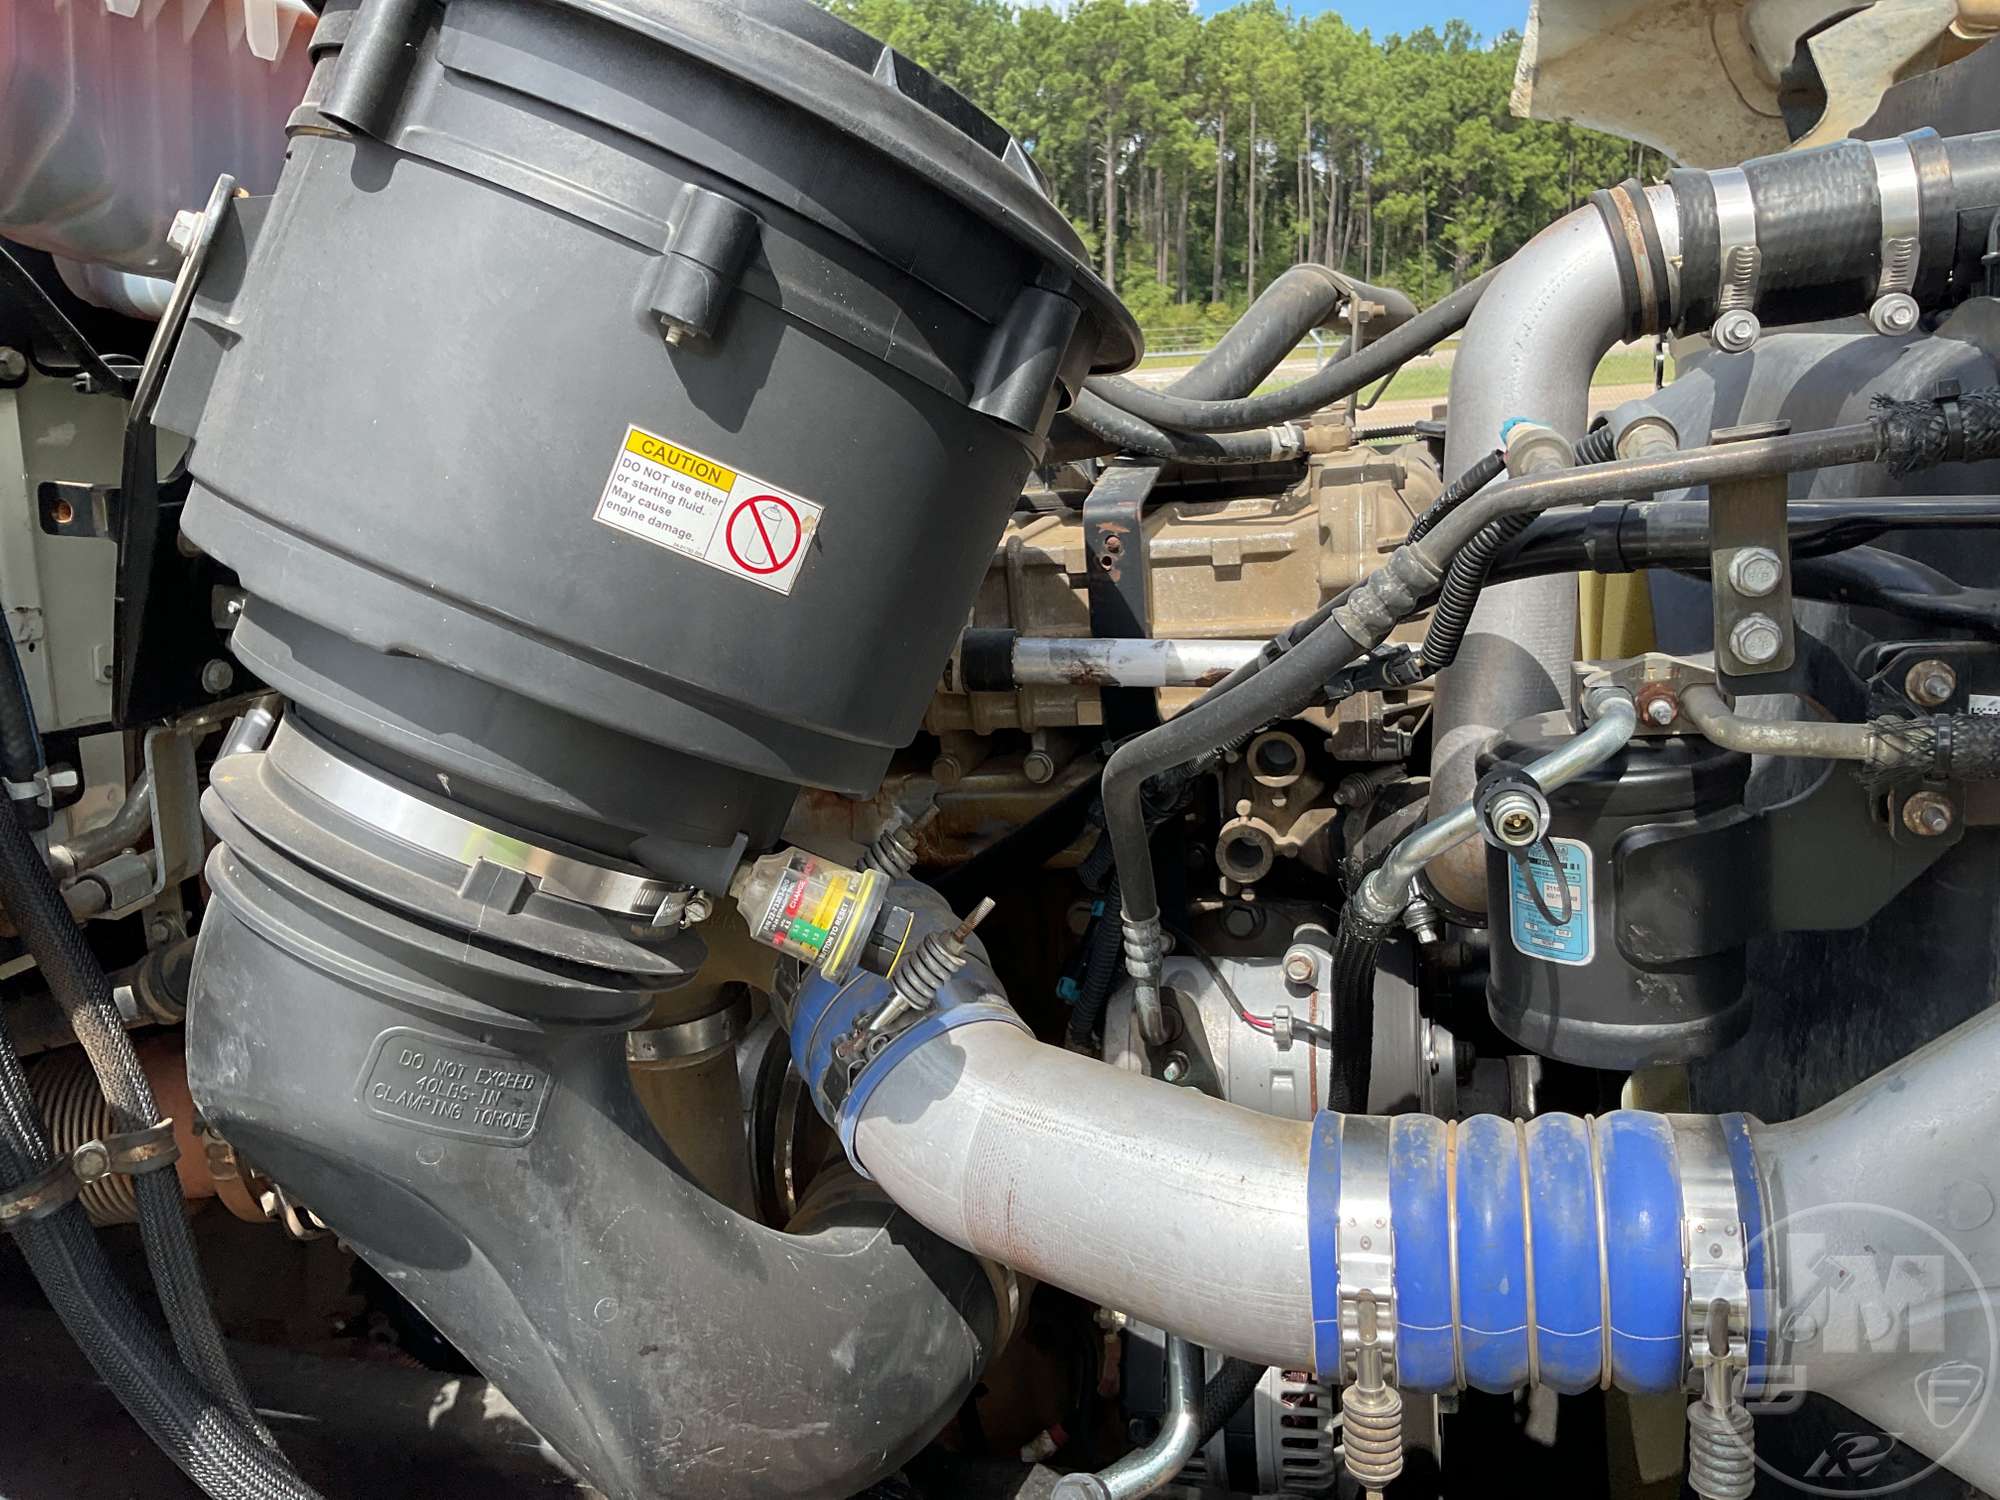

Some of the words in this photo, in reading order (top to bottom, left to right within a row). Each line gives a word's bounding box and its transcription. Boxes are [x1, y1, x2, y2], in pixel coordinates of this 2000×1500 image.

[622, 458, 641, 472] DO
[643, 466, 671, 484] NOT
[671, 479, 692, 494] use
[694, 490, 724, 507] ether
[641, 440, 722, 483] CAUTION
[611, 485, 636, 503] May
[638, 498, 672, 517] cause
[616, 473, 631, 483] or
[632, 479, 676, 504] starting
[677, 497, 705, 515] fluid.
[606, 500, 645, 521] engine
[647, 516, 694, 542] damage.
[788, 879, 806, 909] CHANGE
[834, 902, 849, 925] RESET
[400, 1049, 425, 1069] DO
[432, 1058, 466, 1079] NOT
[474, 1067, 536, 1090] EXCEED
[373, 1082, 463, 1119] CLAMPING
[474, 1107, 531, 1130] TORQUE
